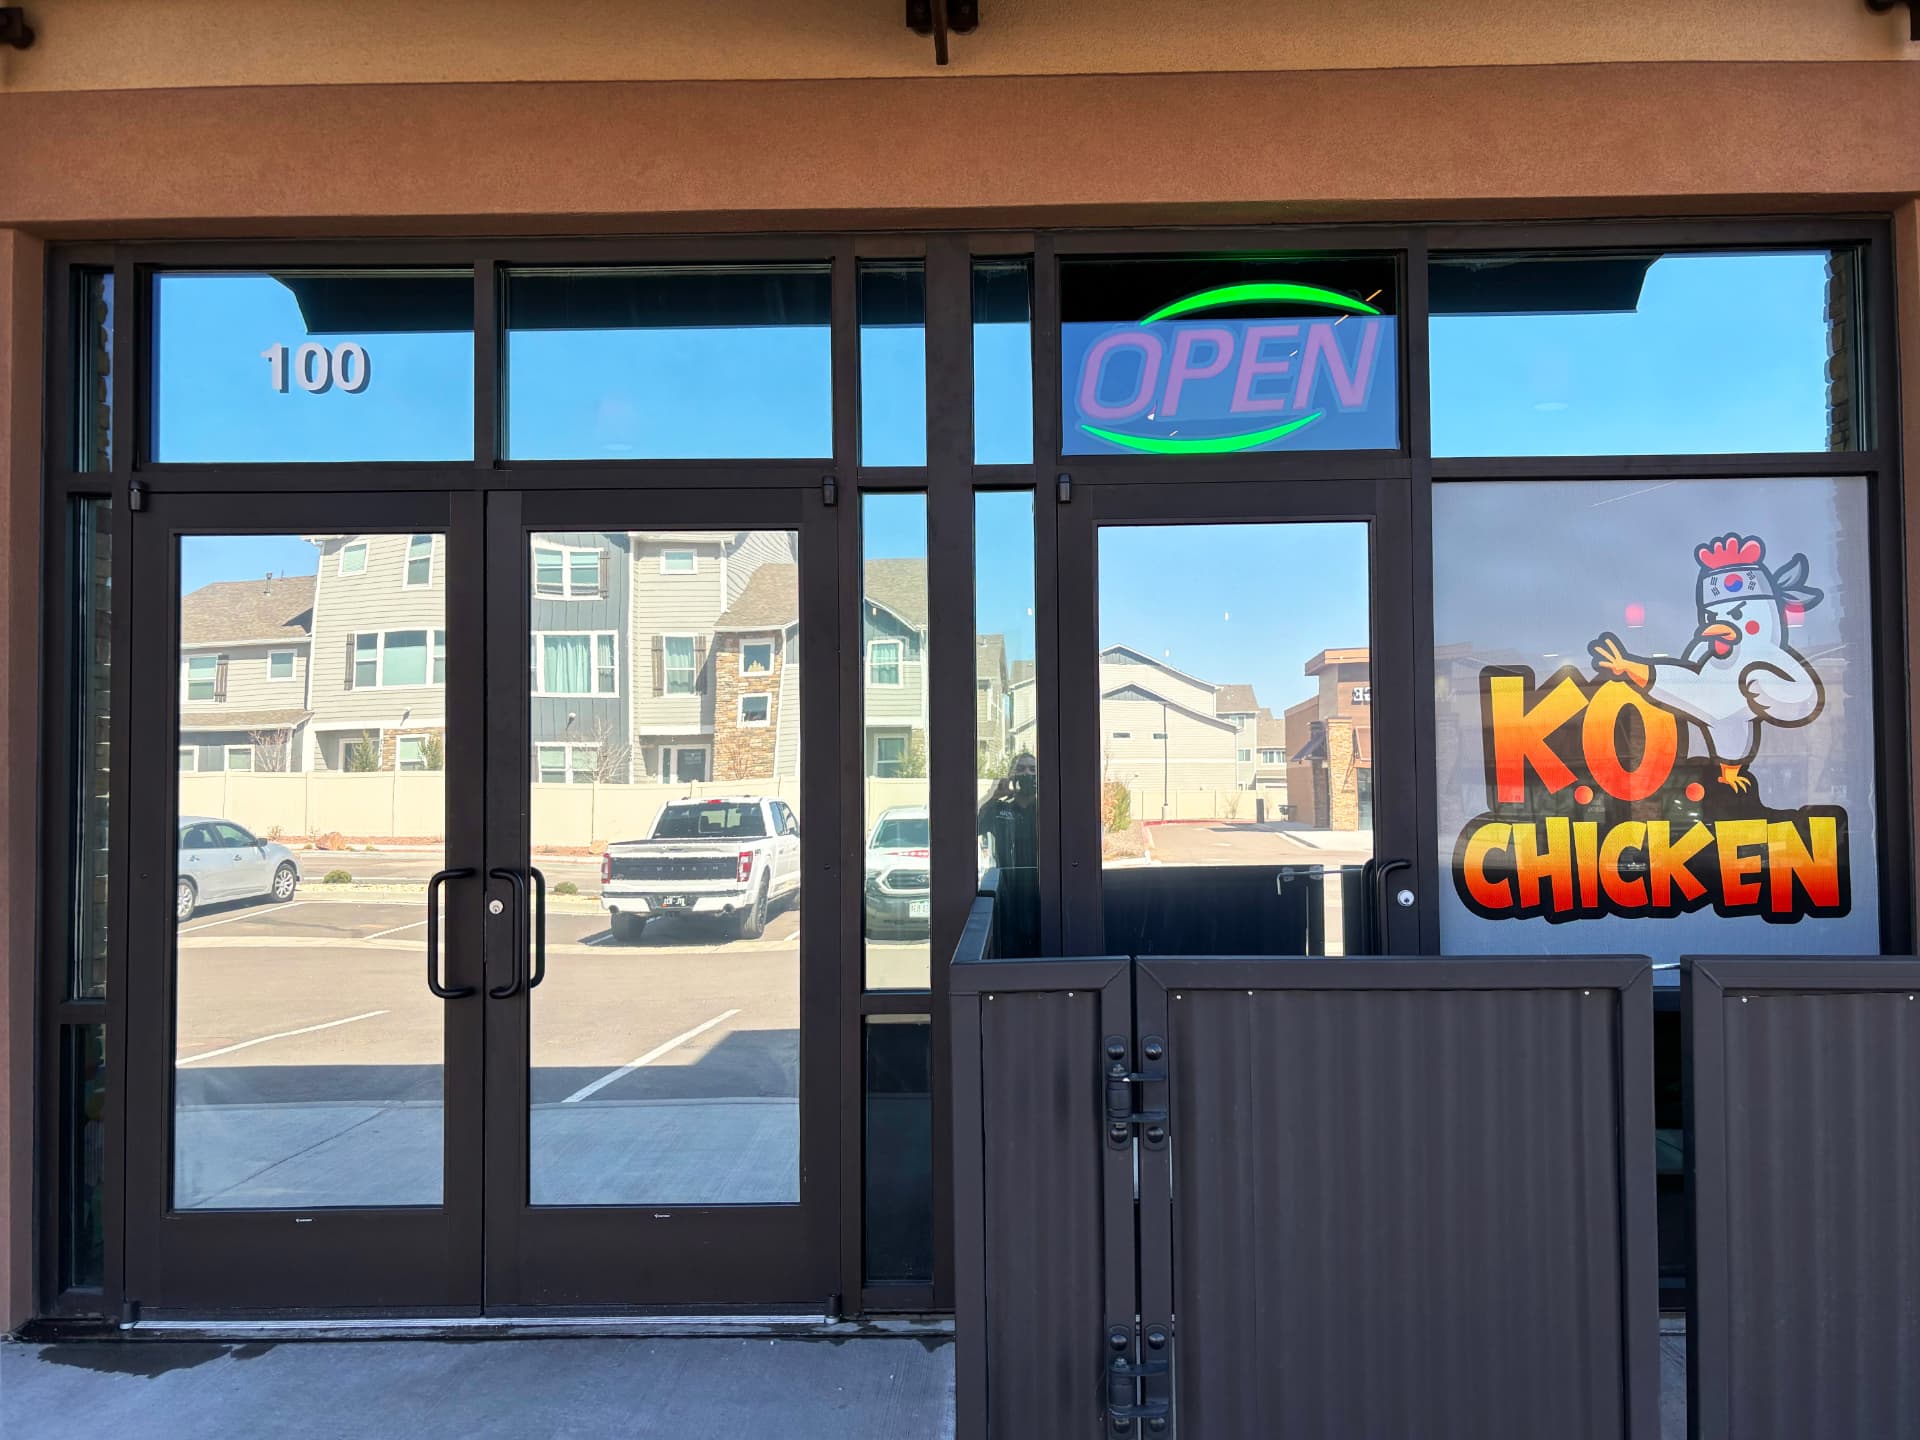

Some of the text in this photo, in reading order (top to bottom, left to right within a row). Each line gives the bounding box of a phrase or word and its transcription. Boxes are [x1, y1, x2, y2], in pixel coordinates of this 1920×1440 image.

[260, 341, 369, 393] 100
[1079, 321, 1380, 420] OPEN
[1490, 676, 1705, 806] K.O.
[1463, 816, 1840, 913] CHICKEN
